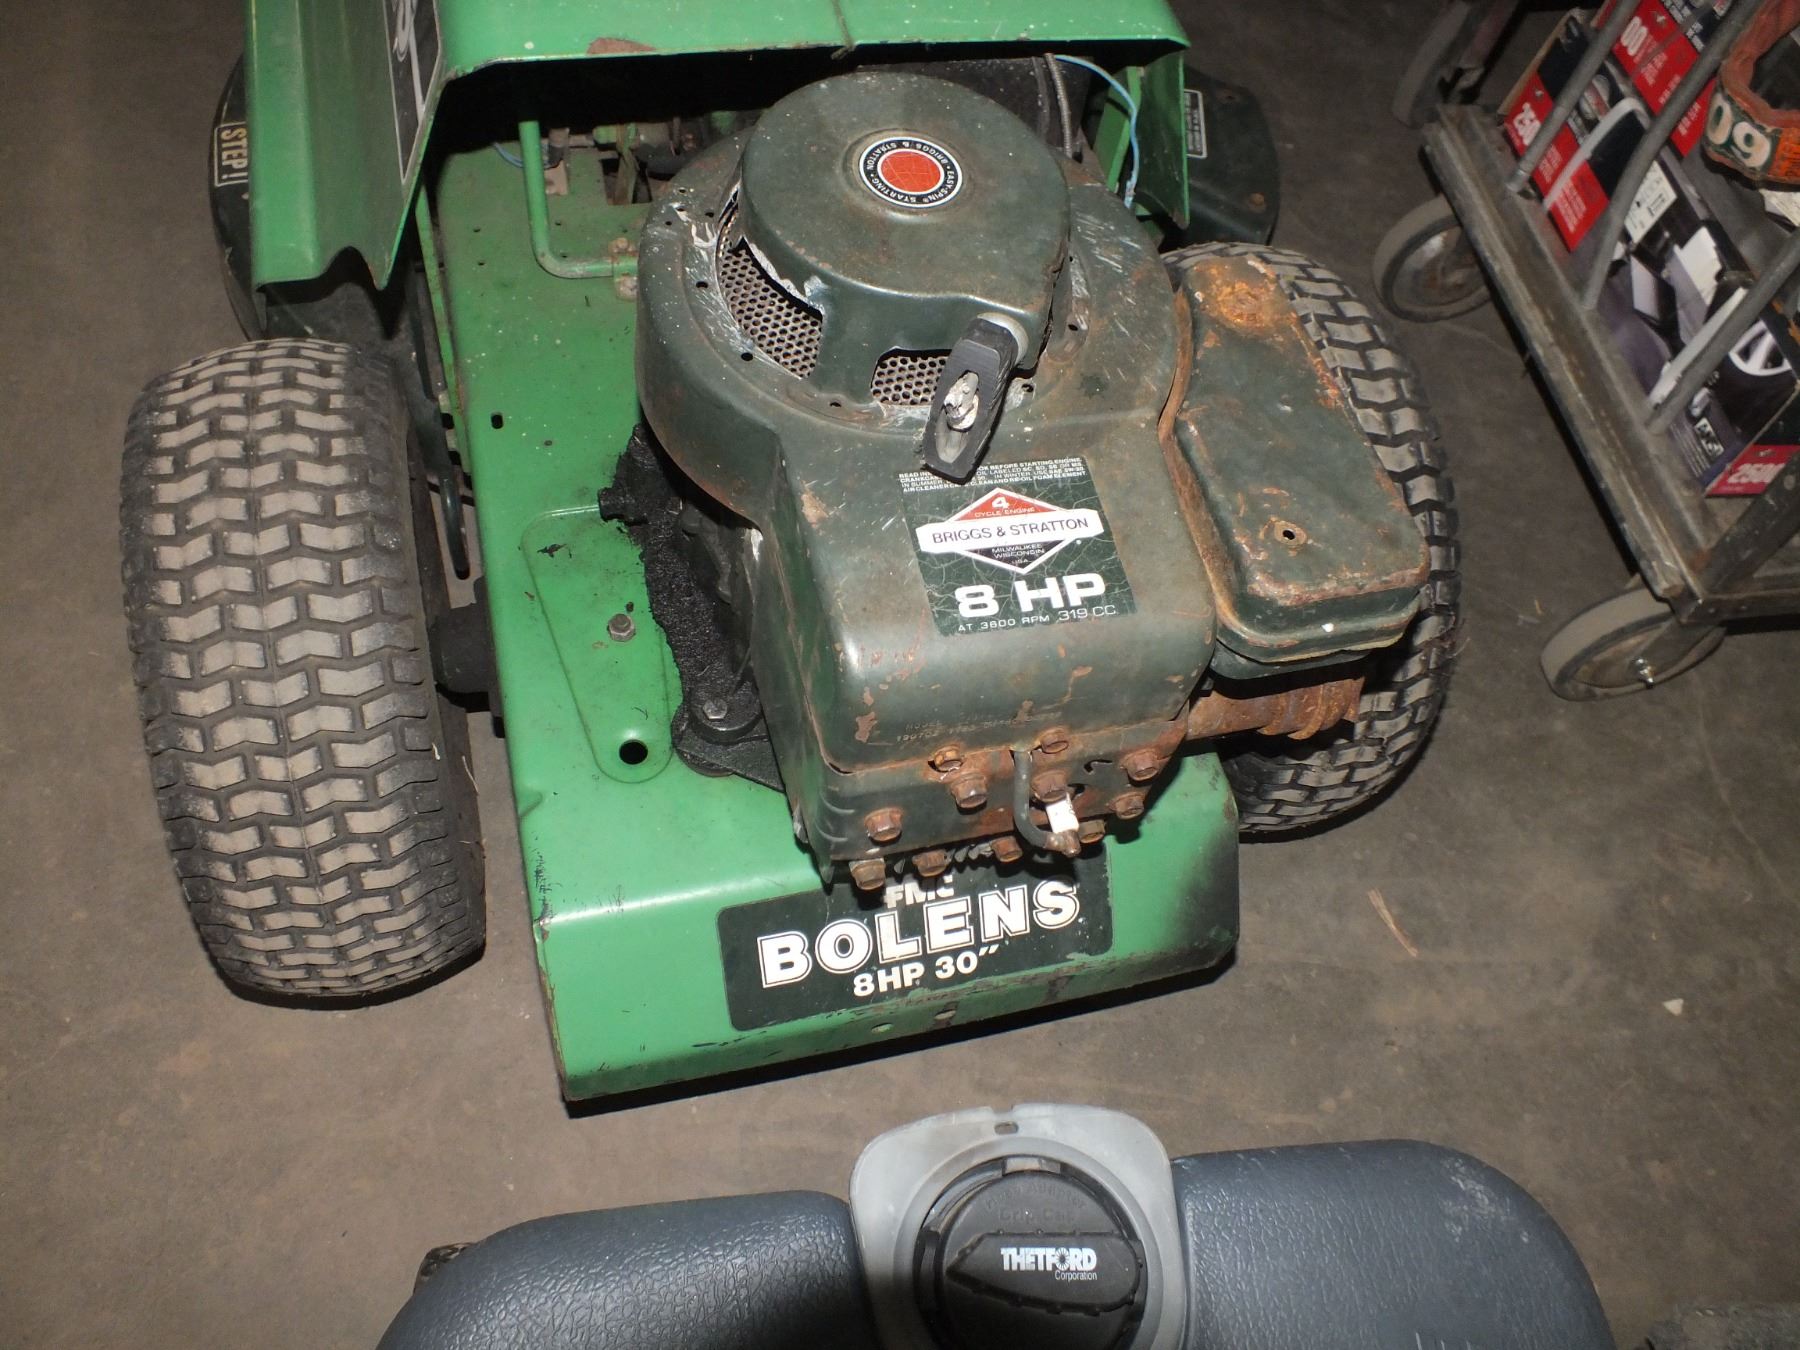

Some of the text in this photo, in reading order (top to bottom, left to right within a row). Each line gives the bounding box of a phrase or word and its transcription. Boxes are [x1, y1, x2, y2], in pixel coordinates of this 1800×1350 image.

[991, 496, 1010, 509] 4
[1004, 506, 1036, 514] ENGINE
[932, 518, 1089, 544] BRIGGS & STRATTON
[992, 544, 1042, 553] MILWAUKEE
[994, 549, 1045, 558] WISCONSIN
[954, 572, 1106, 618] 8 HP
[958, 624, 973, 632] AT
[1022, 614, 1050, 625] RPM
[1058, 608, 1088, 622] 319
[1092, 604, 1117, 616] CC
[757, 879, 1080, 989] BOLENS
[1000, 1247, 1097, 1271] THETFORD
[1054, 1270, 1098, 1282] Corporation
